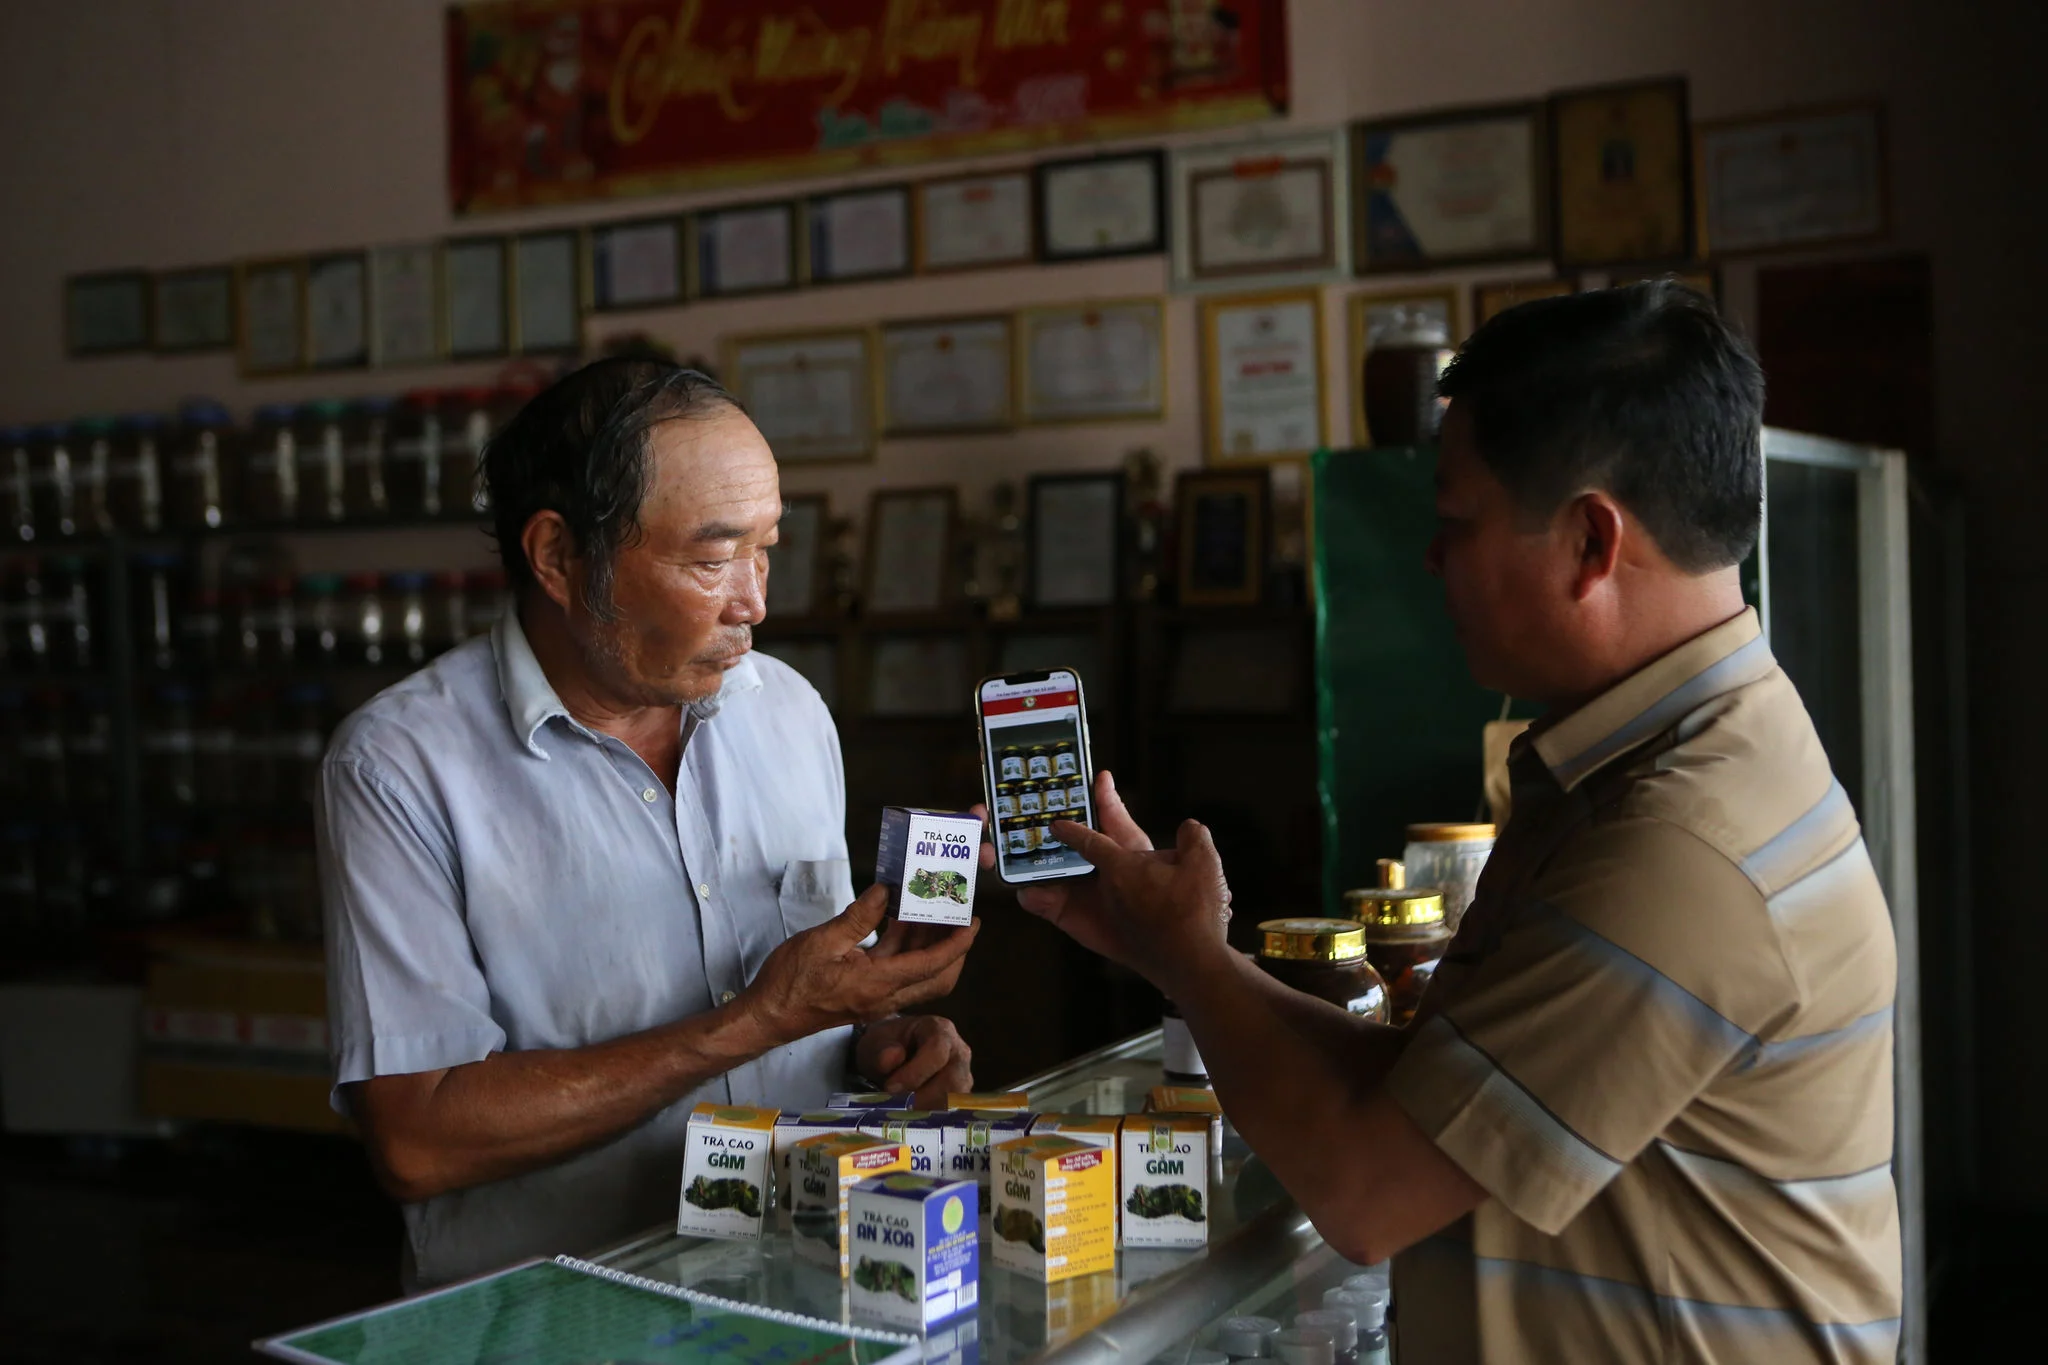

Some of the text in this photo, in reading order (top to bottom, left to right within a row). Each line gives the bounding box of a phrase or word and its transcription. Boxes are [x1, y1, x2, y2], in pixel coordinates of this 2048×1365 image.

[924, 829, 967, 844] TRÀ CAO
[916, 841, 971, 860] AN XOA
[702, 1134, 754, 1150] TRÀ CAO
[911, 1144, 925, 1154] AO
[1170, 1144, 1191, 1154] AO
[911, 1156, 931, 1172] OA
[952, 1155, 975, 1170] AN
[886, 1215, 909, 1229] CAO
[857, 1223, 915, 1249] AN XOA
